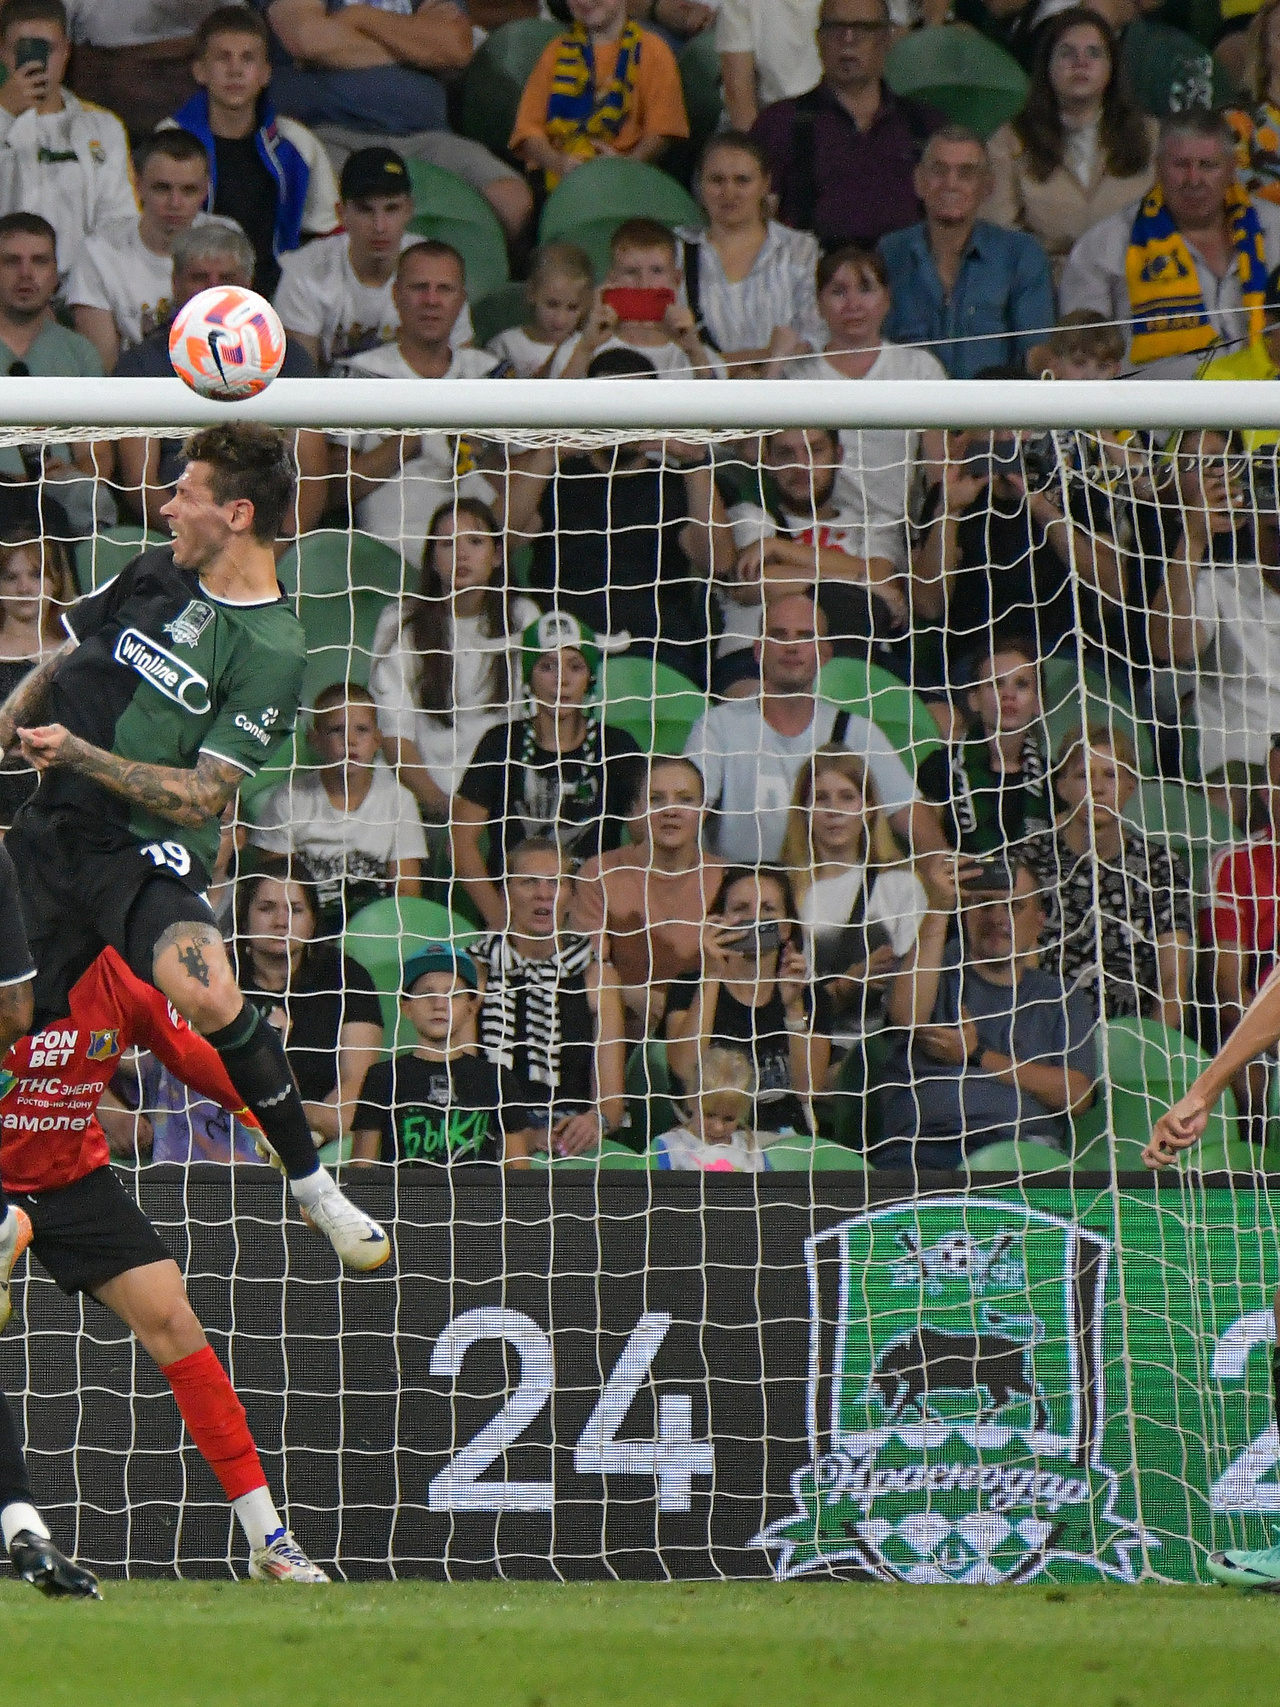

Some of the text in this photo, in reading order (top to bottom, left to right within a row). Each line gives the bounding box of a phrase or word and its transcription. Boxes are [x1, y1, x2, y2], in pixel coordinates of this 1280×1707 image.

[30, 1030, 78, 1050] FON
[29, 1049, 74, 1068] BET
[19, 1078, 104, 1096] ТНС ЭНЕРГО
[0, 1112, 93, 1132] амолет
[428, 1306, 714, 1512] 24
